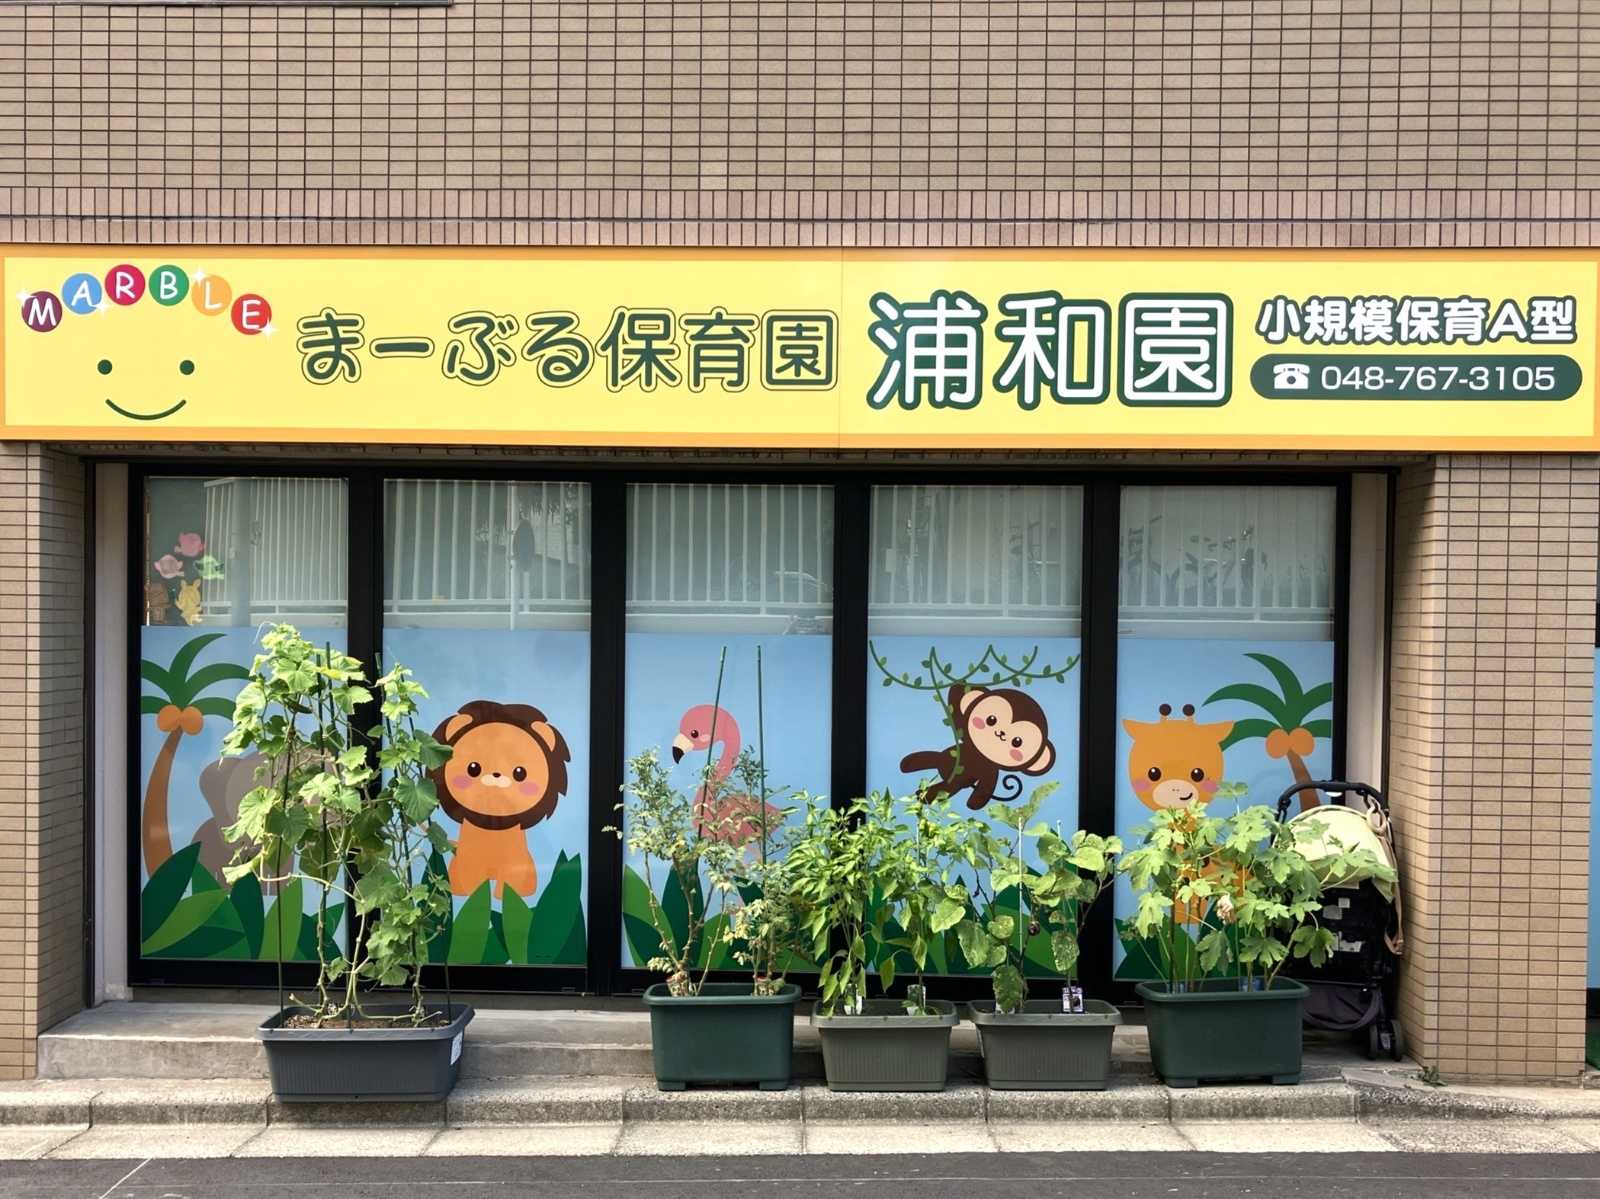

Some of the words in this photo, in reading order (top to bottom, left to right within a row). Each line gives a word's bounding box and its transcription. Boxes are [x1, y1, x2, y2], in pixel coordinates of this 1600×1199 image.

[26, 268, 265, 330] MARBLE
[1257, 296, 1577, 344] 小規模保育A型
[297, 308, 838, 391] まーぶる保育園
[867, 290, 1233, 410] 浦和園
[1321, 366, 1555, 391] 048-767-3105
